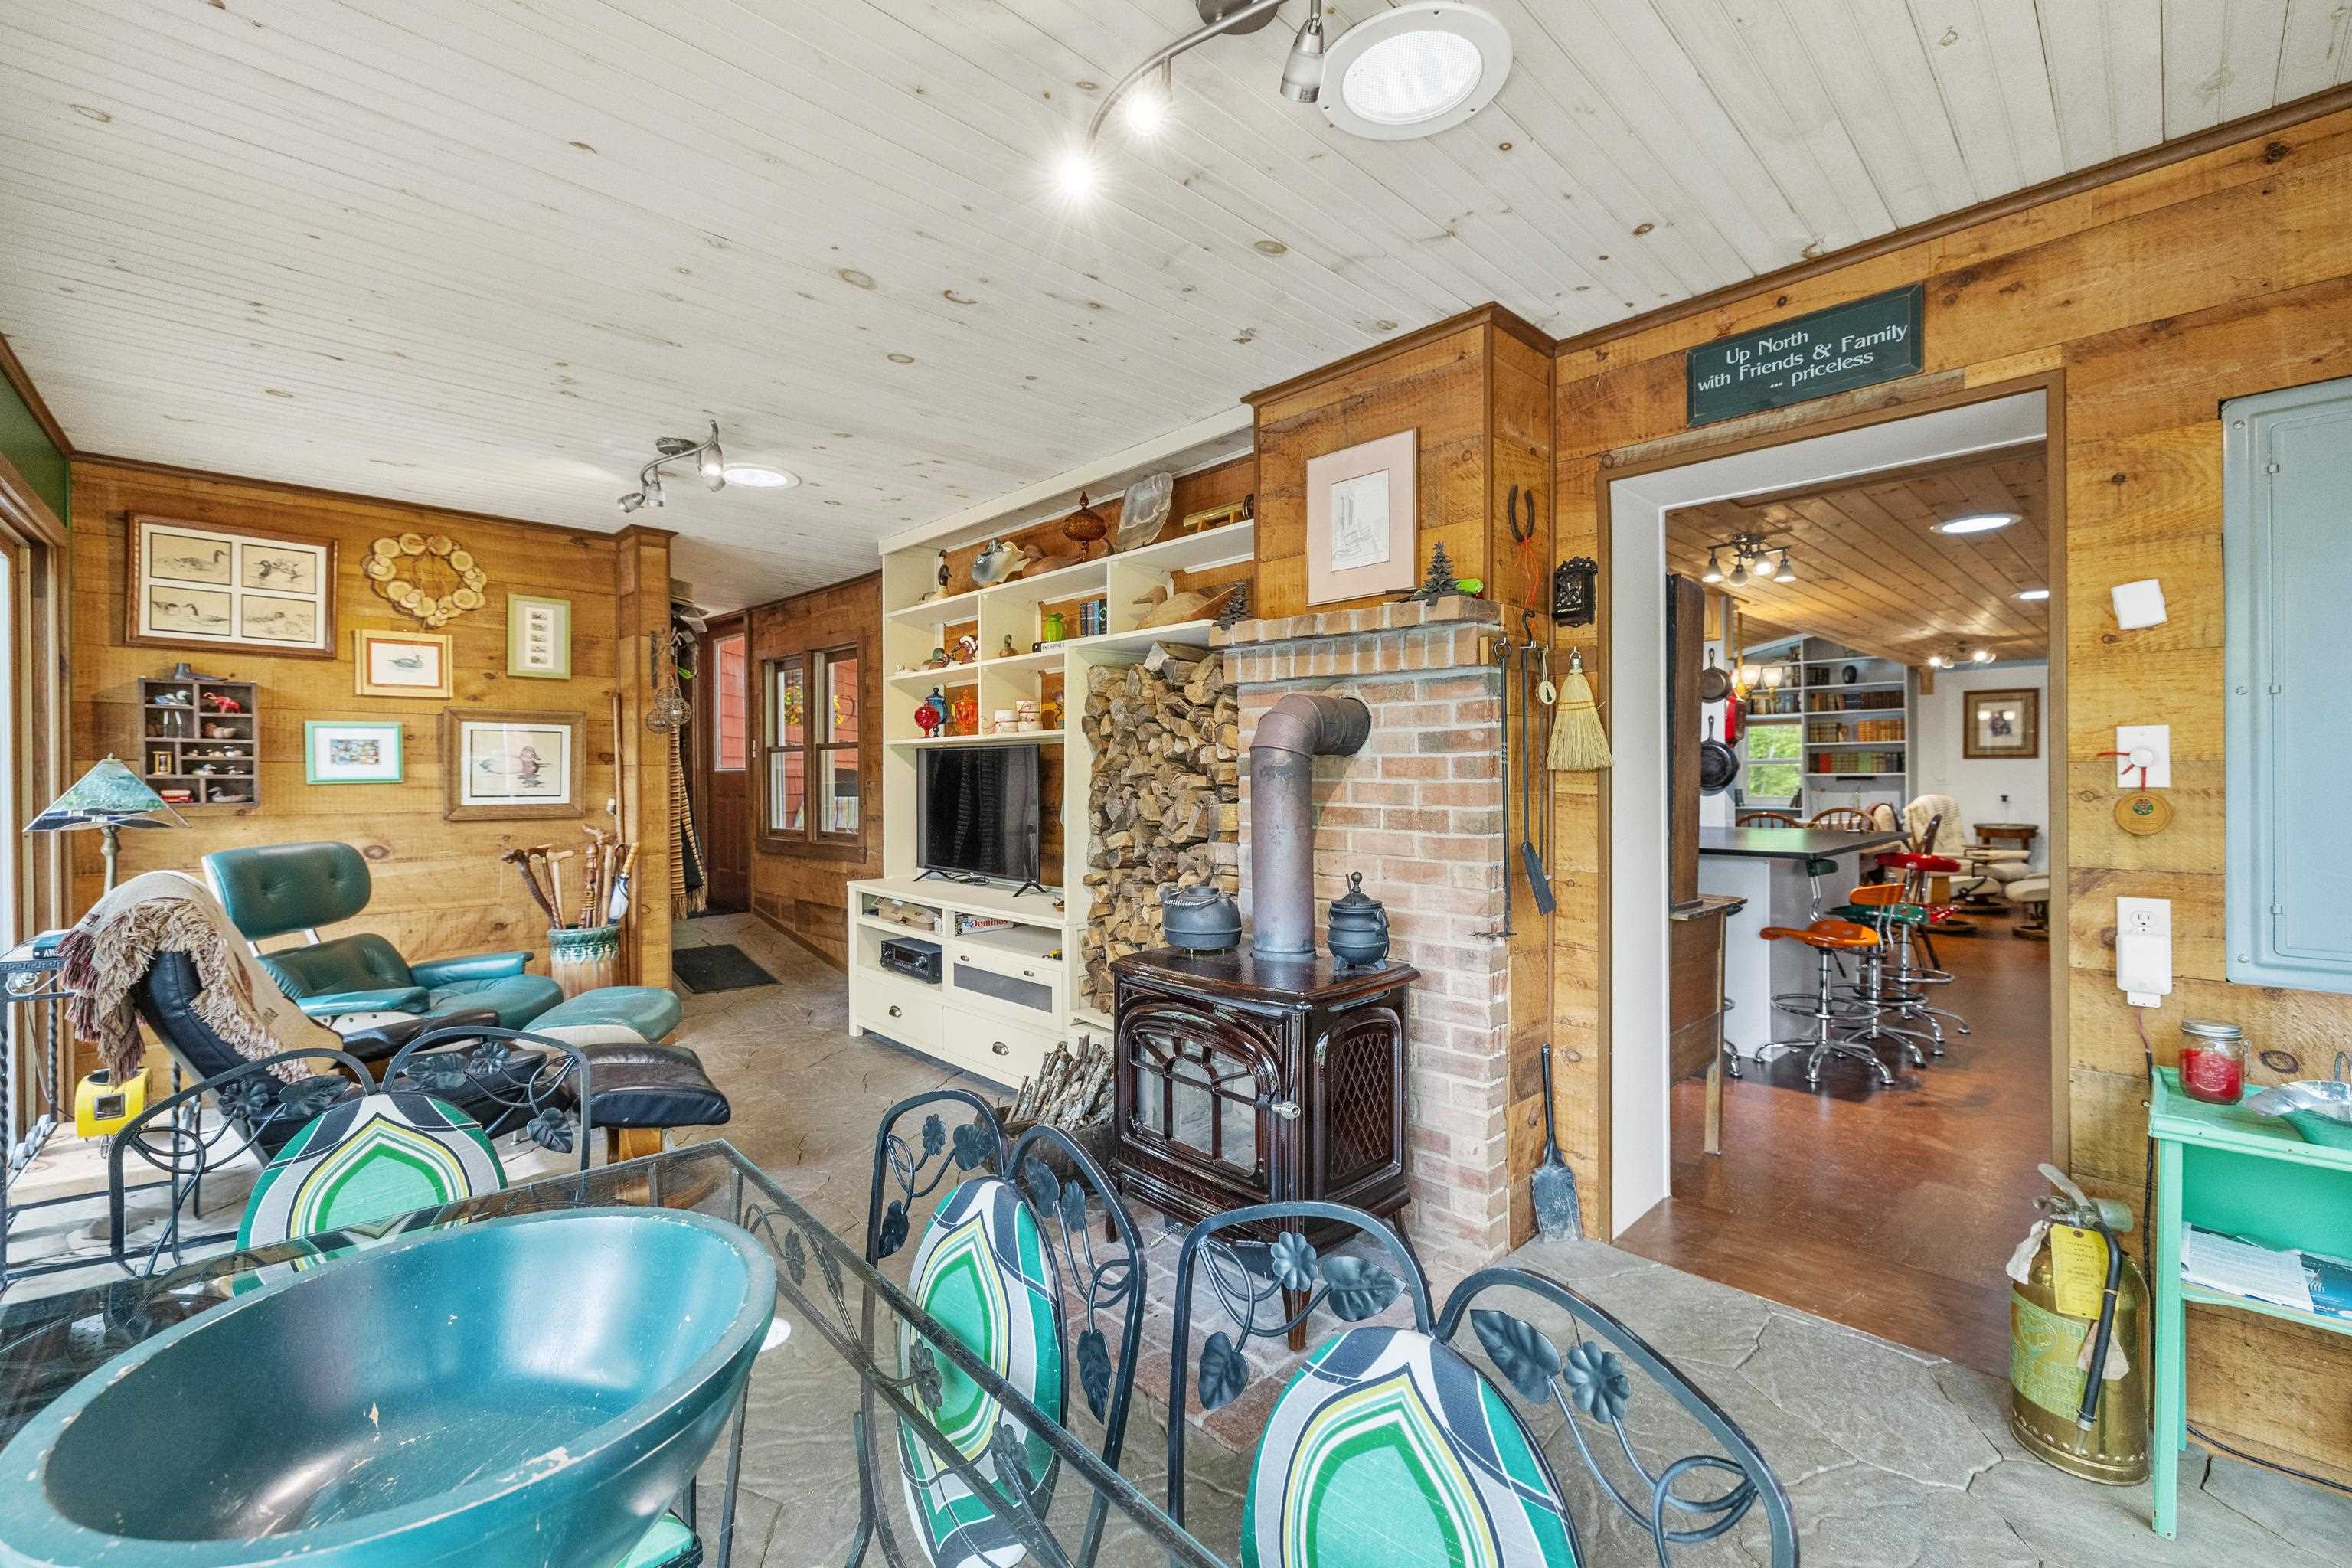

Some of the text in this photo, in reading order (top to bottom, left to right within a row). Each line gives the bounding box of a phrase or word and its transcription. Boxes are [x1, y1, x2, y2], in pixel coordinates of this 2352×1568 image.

[1697, 324, 1909, 392] with Friends & Family
[1726, 331, 1809, 367] Up North
[1791, 352, 1875, 387] priceless
